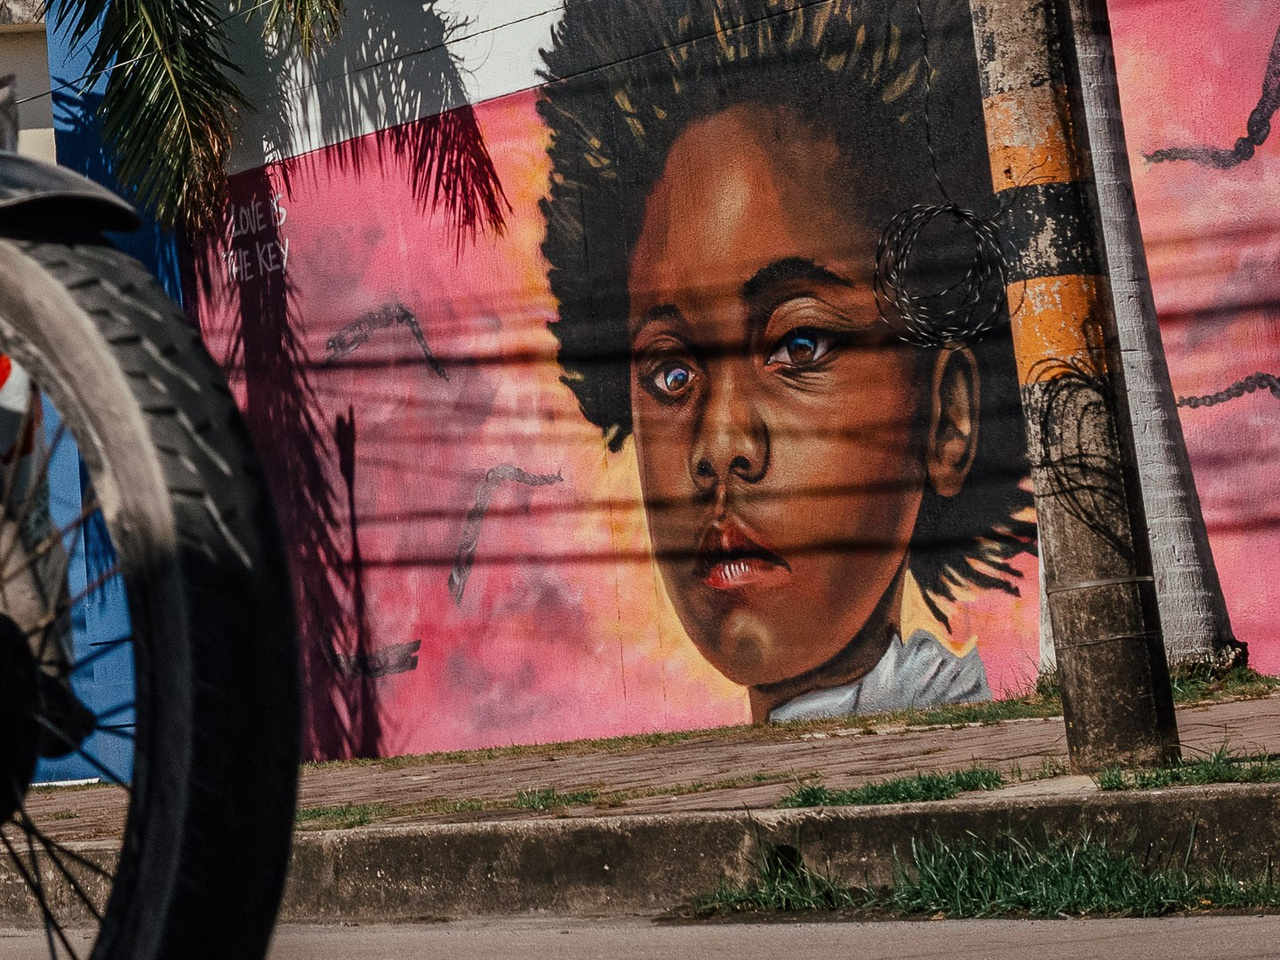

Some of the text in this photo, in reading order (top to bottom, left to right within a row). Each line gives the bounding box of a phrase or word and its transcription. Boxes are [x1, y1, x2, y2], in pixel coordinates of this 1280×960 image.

[230, 193, 287, 237] LOVE IS
[221, 238, 289, 282] THE KEY
